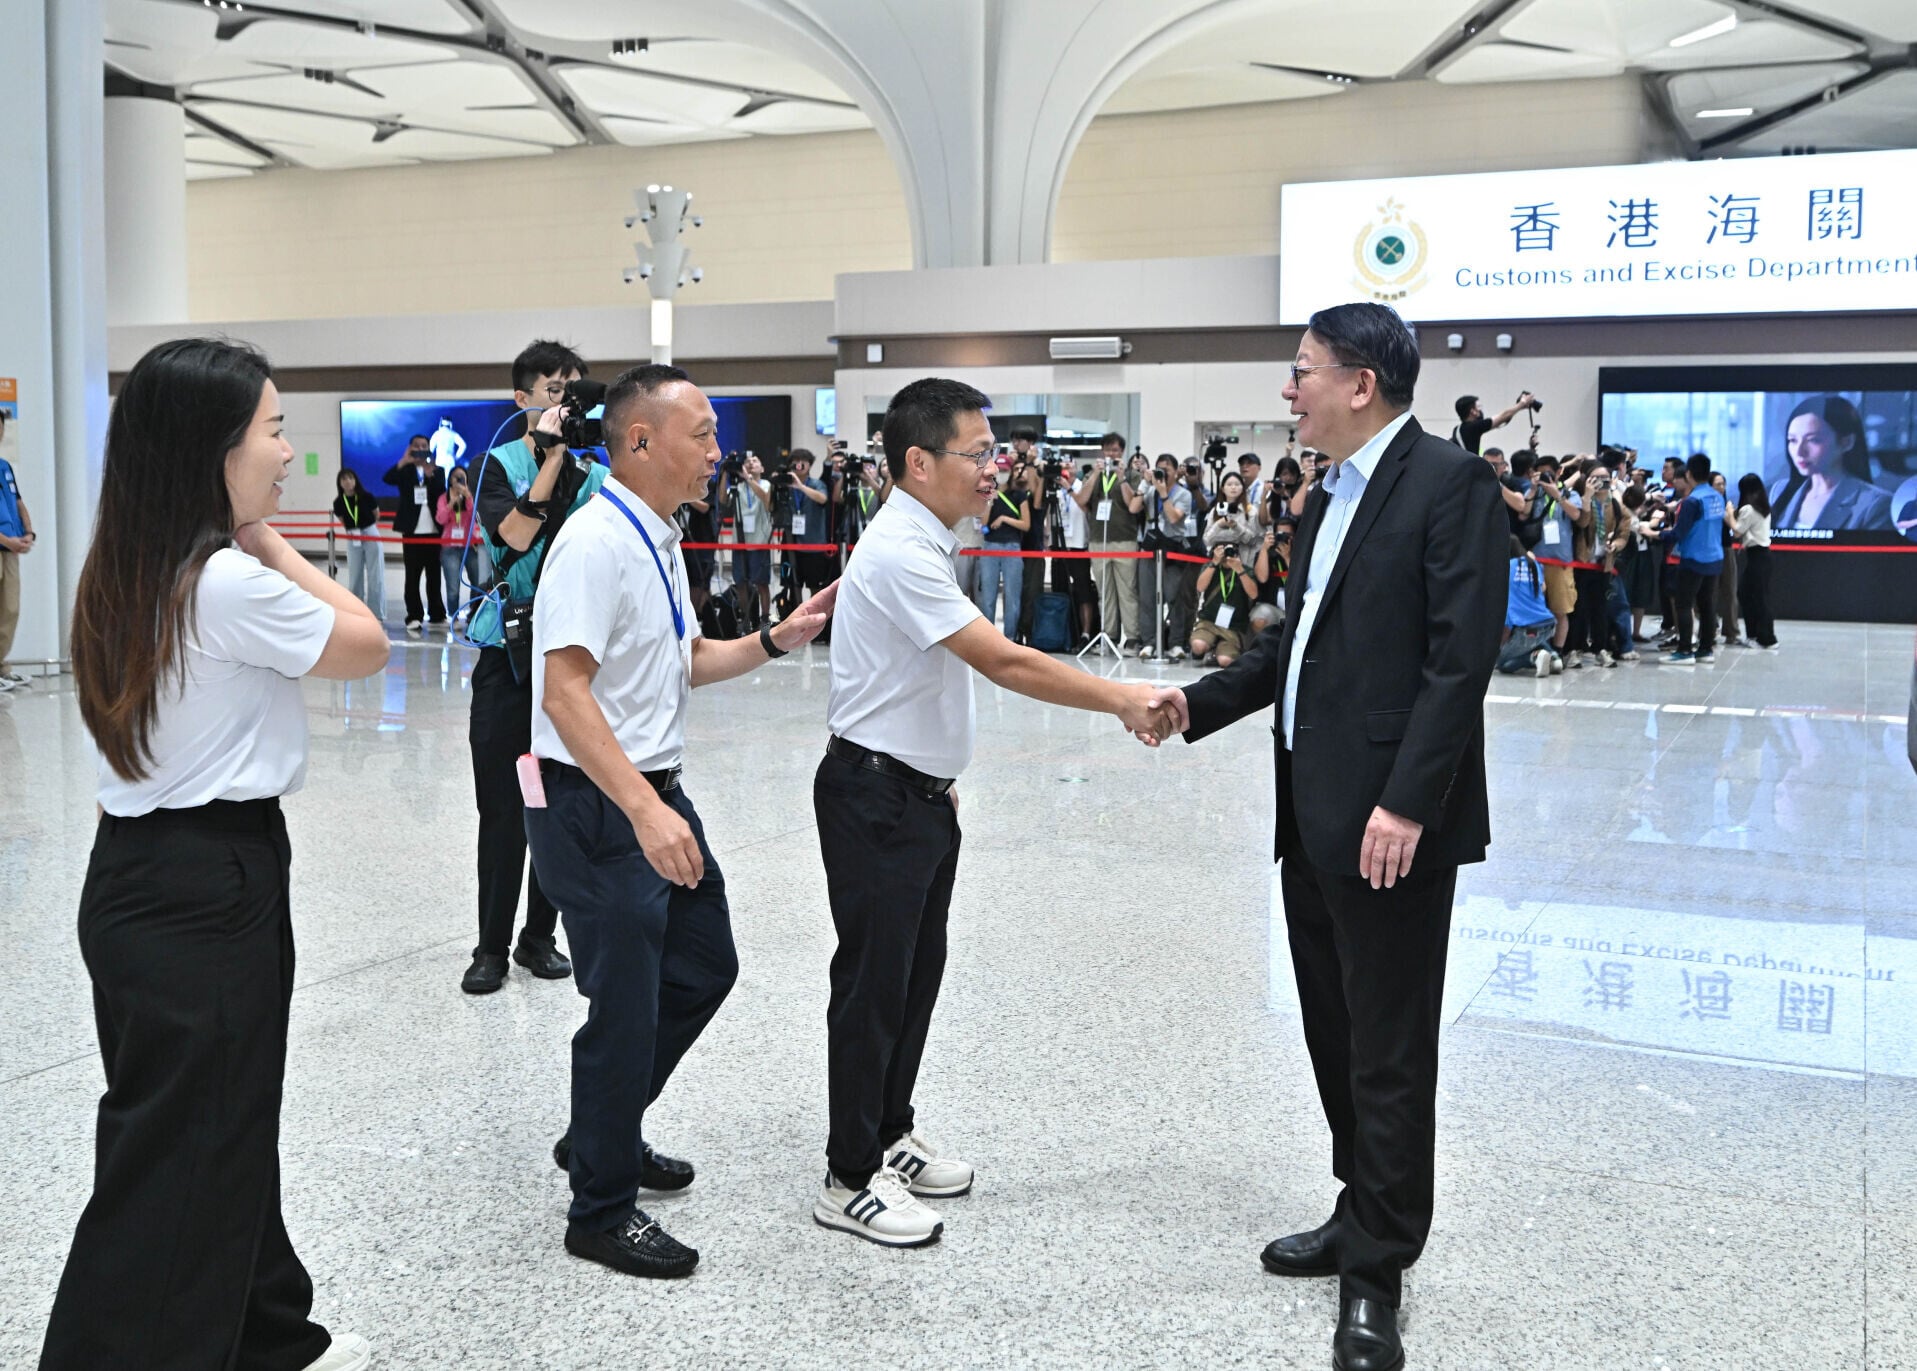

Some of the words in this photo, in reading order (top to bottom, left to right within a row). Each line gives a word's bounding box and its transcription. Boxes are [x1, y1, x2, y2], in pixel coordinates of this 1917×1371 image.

[1509, 187, 1865, 253] 香港海關
[1455, 265, 1573, 288] Customs
[1583, 262, 1633, 284] and
[1644, 258, 1737, 282] Excise
